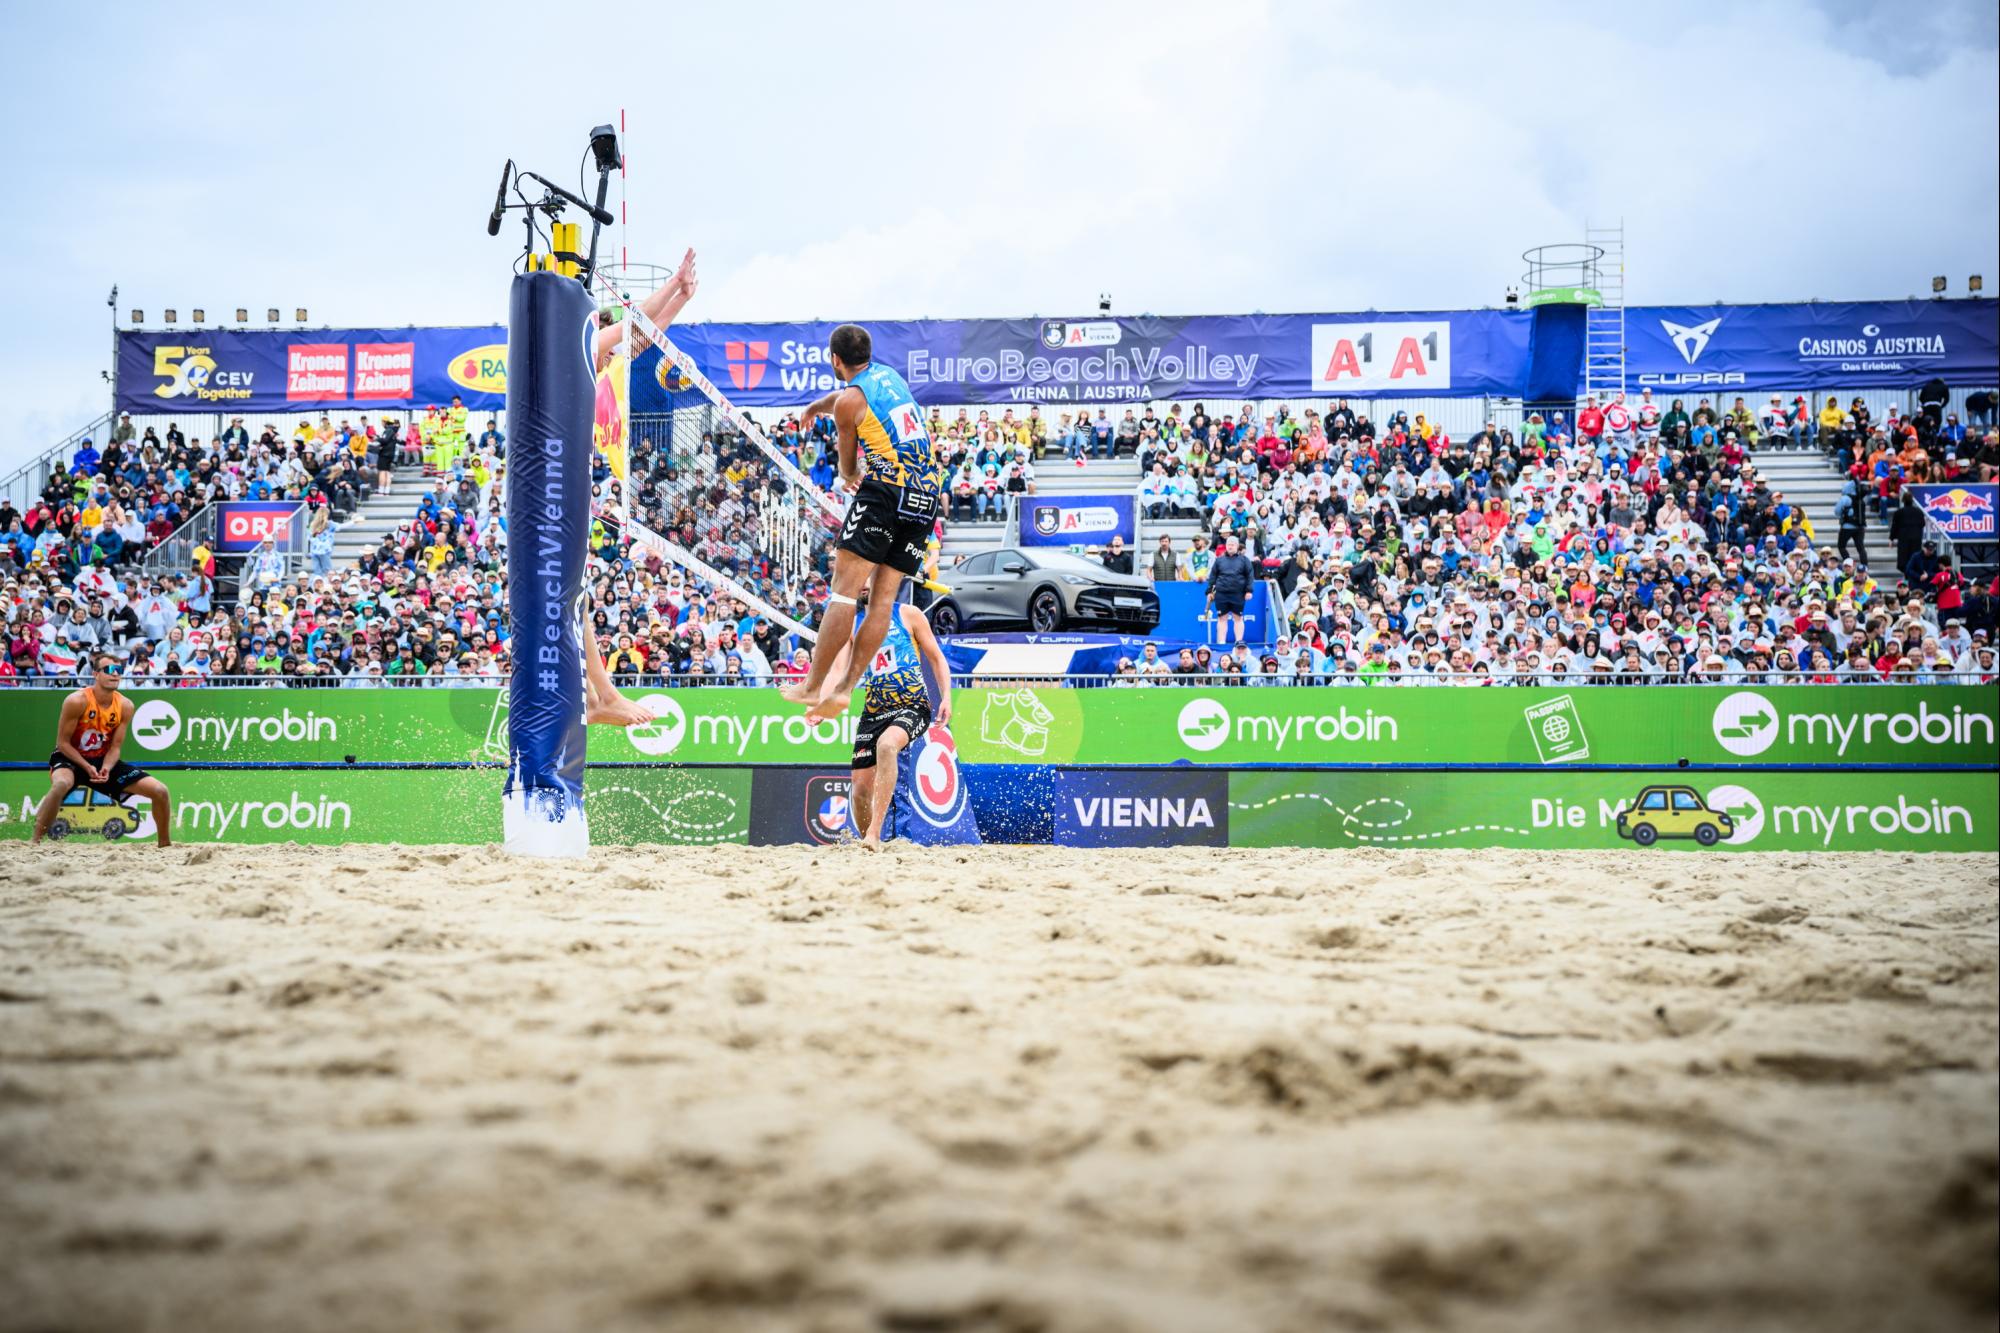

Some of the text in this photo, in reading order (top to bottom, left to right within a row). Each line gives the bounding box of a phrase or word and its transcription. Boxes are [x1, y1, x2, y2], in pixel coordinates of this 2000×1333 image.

[1070, 326, 1087, 343] A1
[1799, 334, 1945, 356] CASINOS AUSTRIA
[186, 346, 211, 355] Years
[357, 351, 411, 371] Kronen
[1324, 331, 1437, 381] A1 A1
[290, 352, 346, 372] Kronen
[908, 346, 1259, 387] EuroBeachVolley
[1841, 362, 1861, 371] Das
[215, 371, 254, 386] CEV
[290, 372, 346, 393] Zeitung
[357, 371, 411, 391] Zeitung
[1639, 373, 1745, 385] CUPRA
[197, 387, 253, 401] Together
[1010, 384, 1152, 400] VIENNA AUSTRIA
[1064, 512, 1081, 529] A1
[1960, 515, 1994, 533] Bull
[537, 439, 563, 691] #BeachVienna
[876, 650, 892, 671] A1
[1528, 699, 1570, 720] PASSPORT
[187, 708, 337, 751] myrobin
[1237, 706, 1397, 751] myrobin
[1788, 701, 1994, 756] myrobin
[824, 782, 852, 792] CEV
[176, 791, 351, 839] myrobin
[1073, 797, 1215, 828] VIENNA
[1531, 798, 1586, 828] Die
[1773, 795, 1974, 846] myrobin
